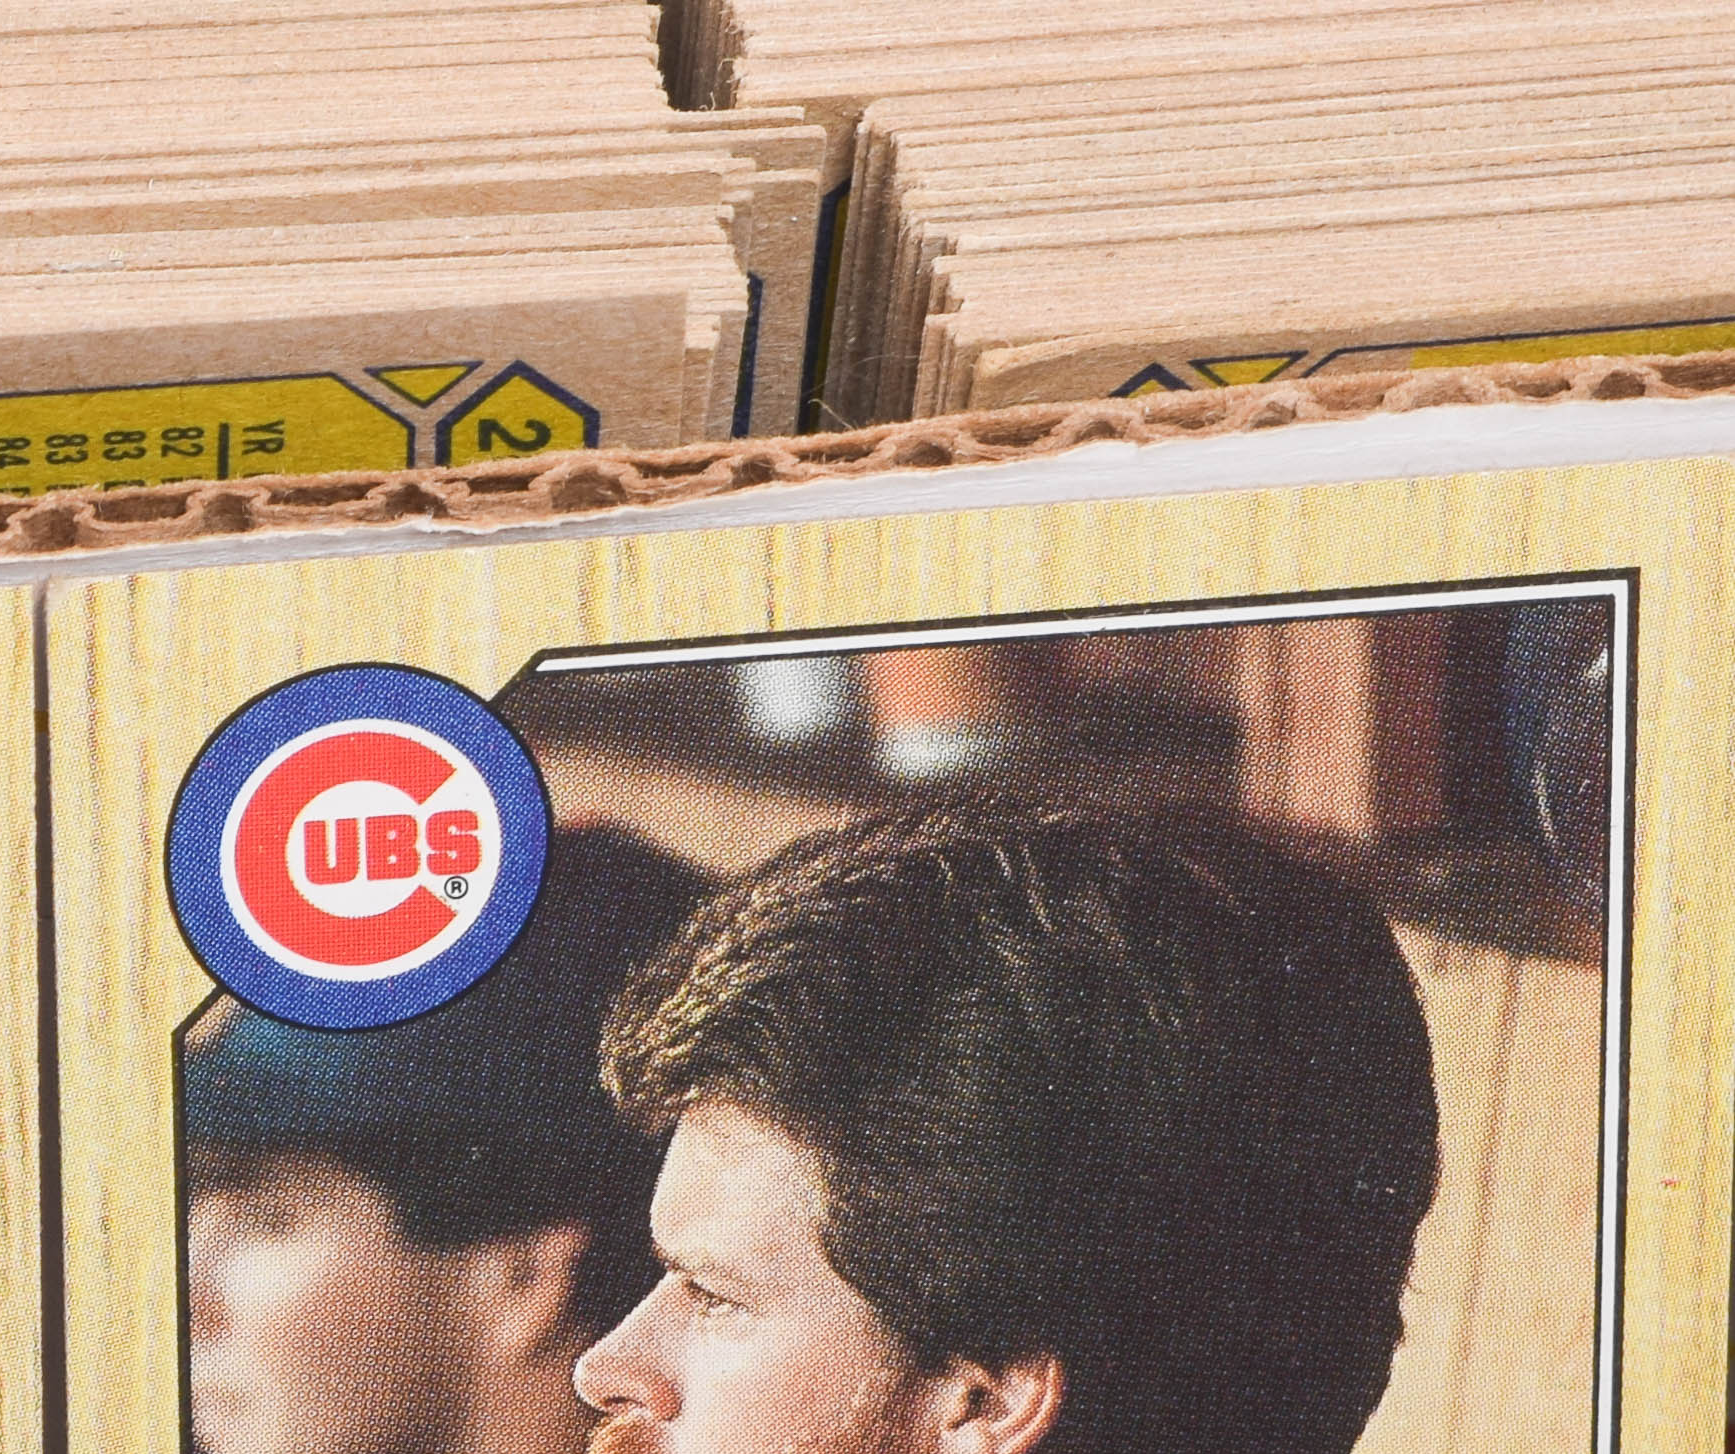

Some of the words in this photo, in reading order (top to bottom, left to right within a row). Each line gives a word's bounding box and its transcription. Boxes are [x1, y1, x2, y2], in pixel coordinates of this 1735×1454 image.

[45, 434, 88, 465] 83
[104, 430, 146, 461] 83
[160, 427, 204, 458] 82
[242, 420, 285, 455] YR
